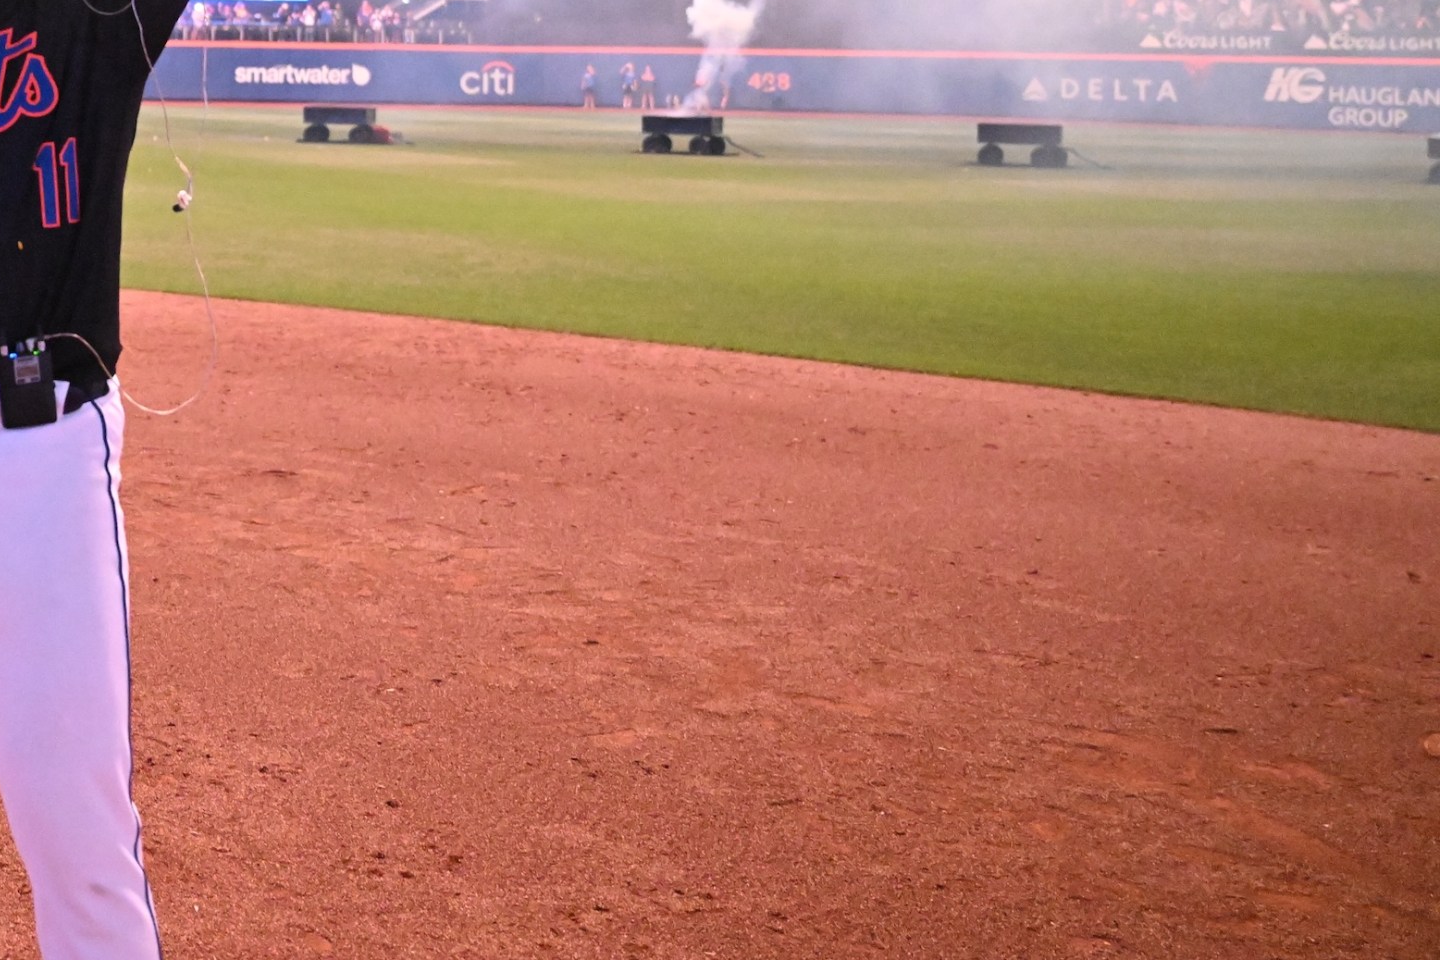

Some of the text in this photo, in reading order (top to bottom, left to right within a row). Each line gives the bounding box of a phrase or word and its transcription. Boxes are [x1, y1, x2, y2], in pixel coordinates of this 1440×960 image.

[1221, 36, 1273, 50] LIGHT
[235, 64, 350, 85] smartwater
[460, 61, 514, 96] citi
[1060, 78, 1178, 102] DELTA
[1328, 106, 1408, 127] GROUP
[34, 138, 81, 228] 11
